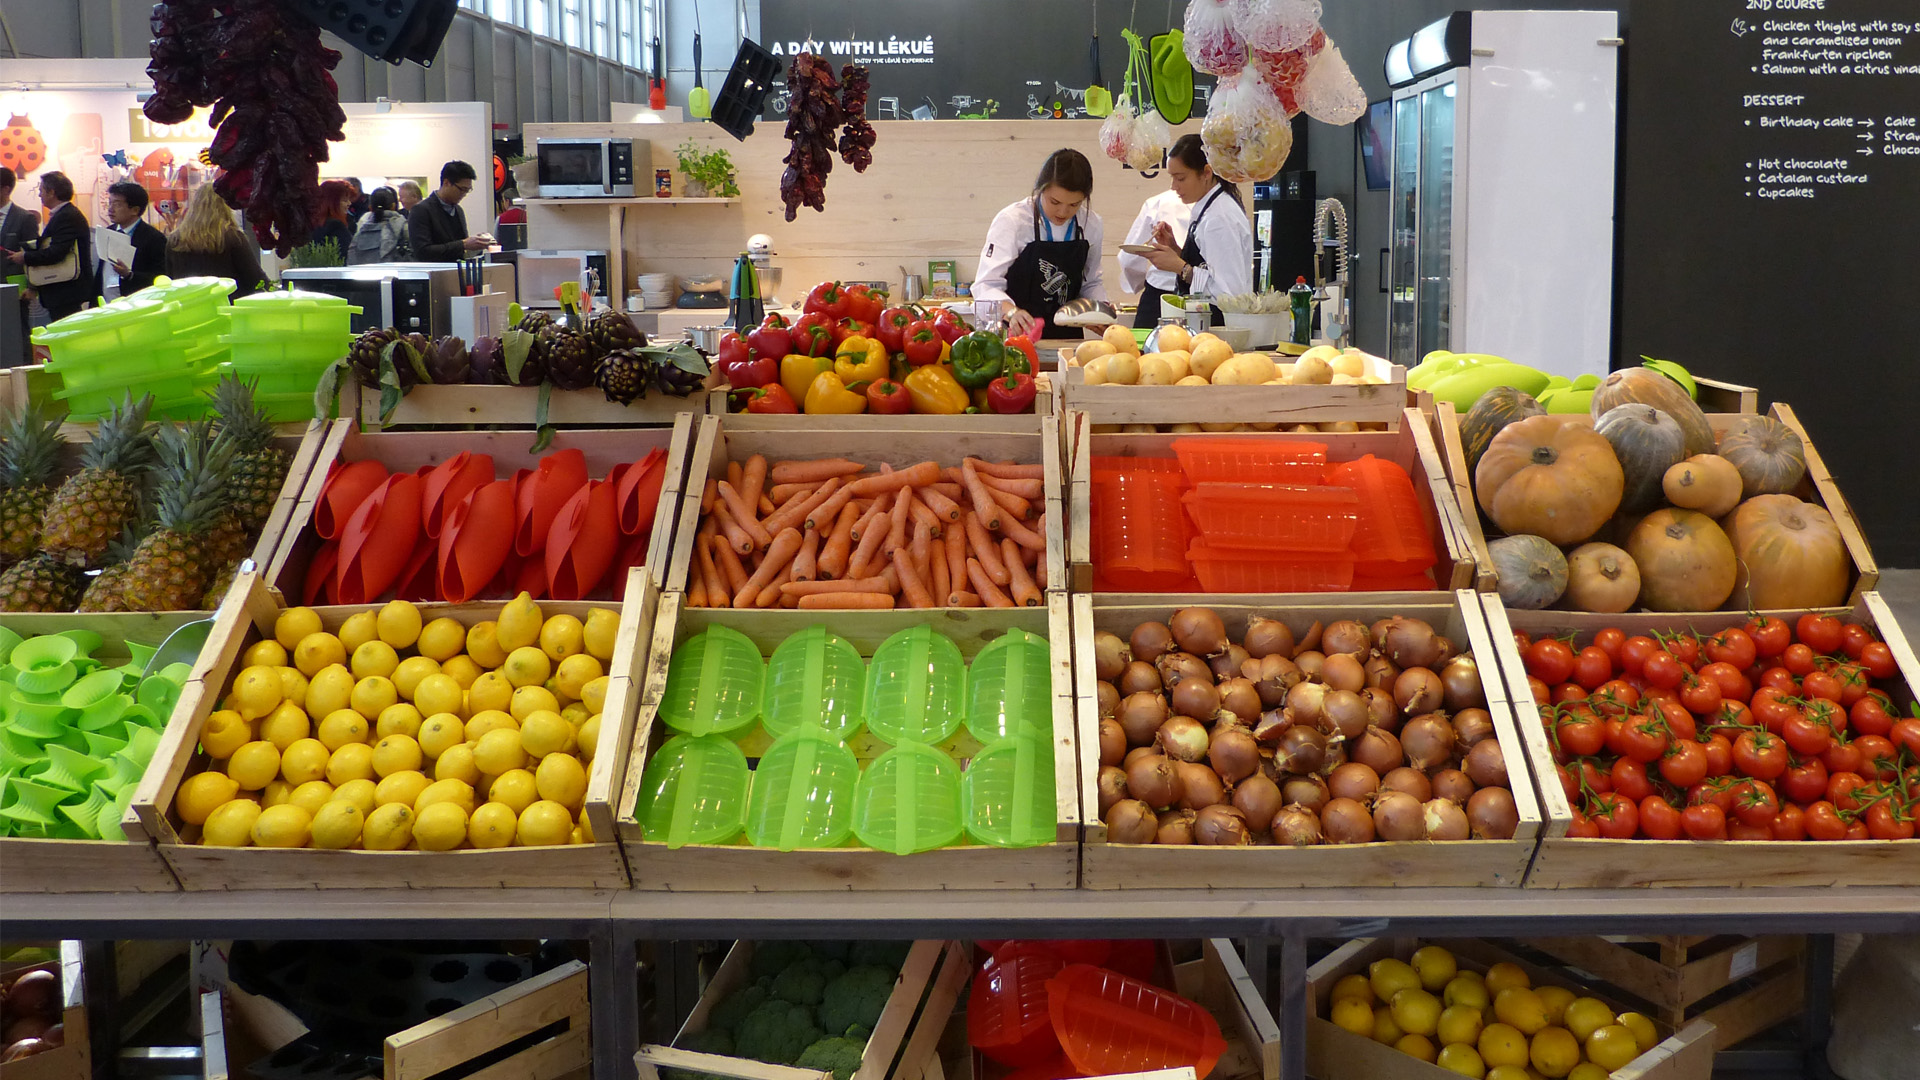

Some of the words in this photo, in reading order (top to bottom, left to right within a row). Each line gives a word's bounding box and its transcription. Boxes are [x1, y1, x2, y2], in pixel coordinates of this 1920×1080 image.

[1745, 0, 1772, 10] 2ND
[1775, 0, 1826, 9] COURSE
[1763, 20, 1810, 32] Chicken
[1814, 20, 1857, 34] thighs
[1860, 20, 1888, 32] with
[1891, 22, 1911, 34] soy
[771, 41, 784, 55] A
[788, 41, 825, 55] DAY
[829, 41, 875, 55] WITH
[878, 35, 934, 55] LÉKUÉ
[1762, 36, 1789, 46] and
[1791, 36, 1870, 47] caramelised
[1872, 37, 1902, 46] onion
[1846, 49, 1892, 62] ripchen
[1761, 63, 1806, 75] Salmon
[1808, 63, 1837, 75] with
[1841, 65, 1851, 74] a
[1853, 63, 1890, 75] citrus
[1744, 94, 1805, 107] DESSERT
[1760, 116, 1820, 129] Birthday
[1822, 116, 1854, 127] cake
[1884, 116, 1916, 127] Cake
[1883, 144, 1920, 155] Choco
[1758, 158, 1781, 170] Hot
[1783, 158, 1848, 170] chocolate
[1758, 173, 1813, 183] Catalan
[1816, 172, 1868, 183] custard
[1757, 187, 1815, 200] Cupcakes
